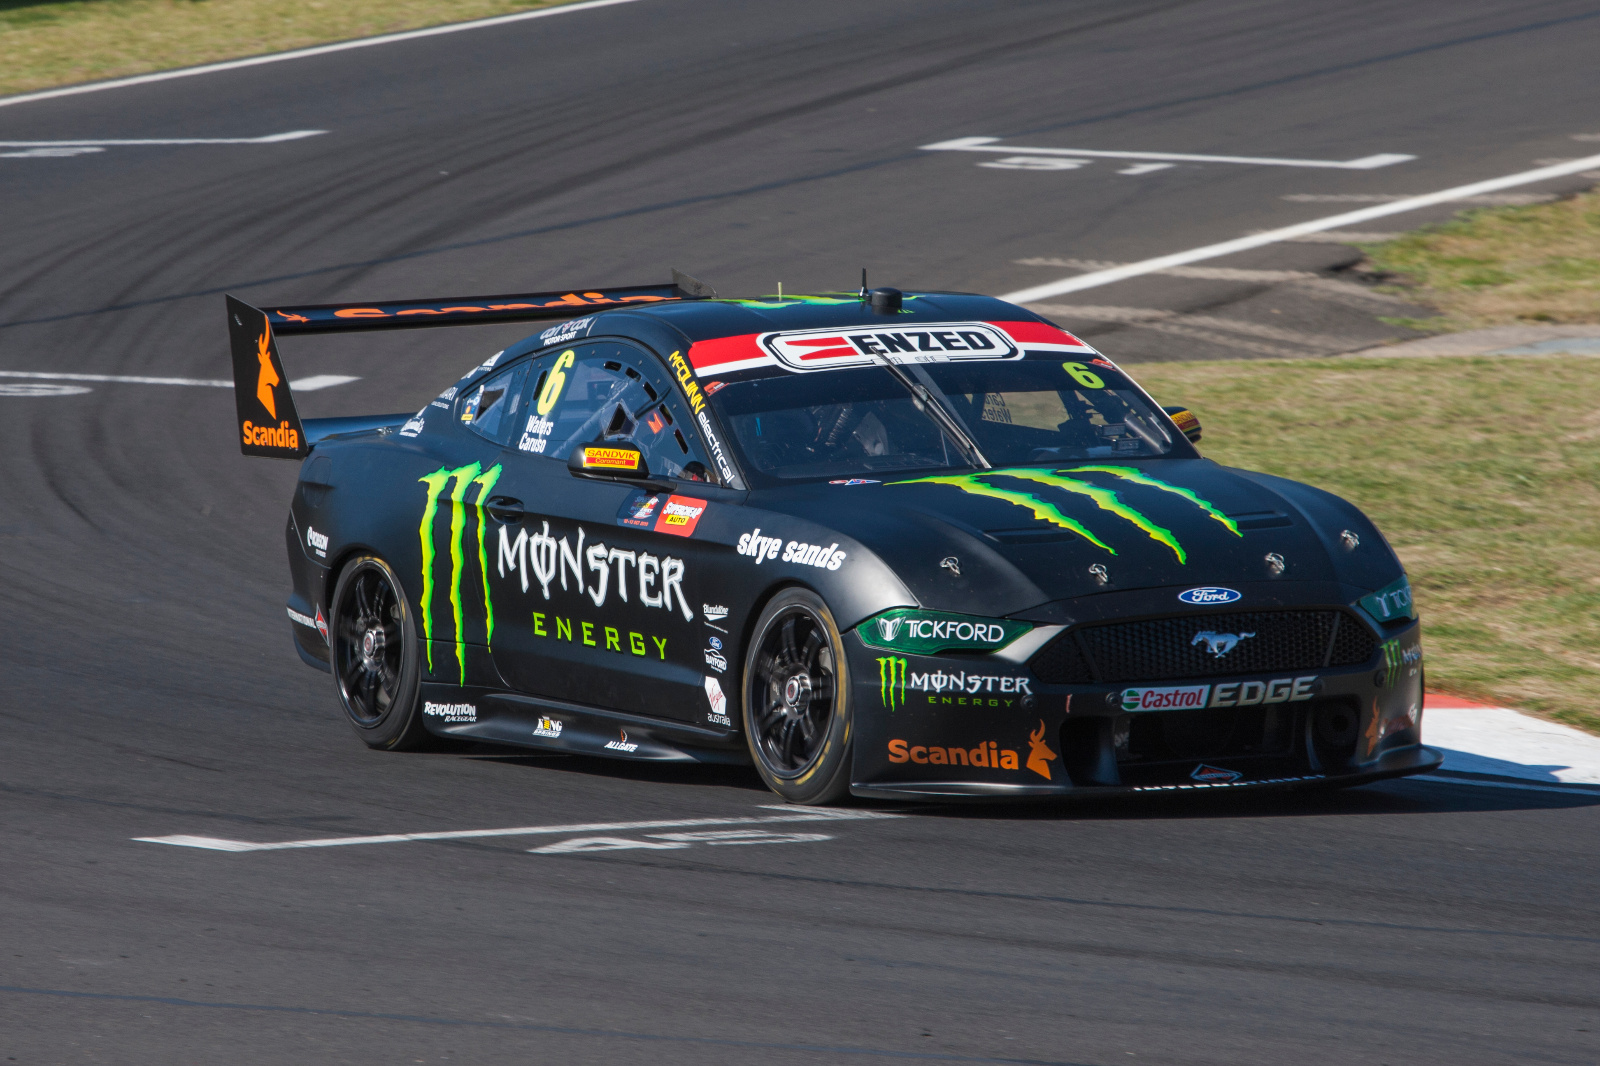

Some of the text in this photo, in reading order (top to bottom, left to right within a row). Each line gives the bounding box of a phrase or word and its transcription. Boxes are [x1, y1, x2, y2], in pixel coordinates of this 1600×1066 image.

[847, 330, 994, 355] ENZED
[536, 349, 575, 416] 6
[1061, 361, 1105, 389] 6
[242, 420, 299, 449] Scandia
[525, 415, 554, 436] Waters
[518, 432, 547, 454] Caruso
[698, 411, 735, 484] electrical
[586, 449, 637, 460] SANDVIK
[595, 457, 626, 466] Coromant
[662, 502, 703, 520] SUPERCHEAP
[668, 515, 687, 524] AUTO
[736, 528, 847, 571] skye sands
[1191, 589, 1229, 602] Ford
[532, 611, 668, 661] ENERGY
[905, 619, 1005, 643] TICKFORD
[705, 654, 727, 671] BAYFORD
[928, 696, 1014, 707] ENERGY
[1141, 675, 1319, 709] Castrol EDGE
[424, 701, 476, 716] REVOLUTION
[444, 715, 477, 723] RACEGEAR
[707, 713, 731, 727] australia
[604, 740, 639, 752] ALLGATE
[887, 739, 1019, 770] Scandia
